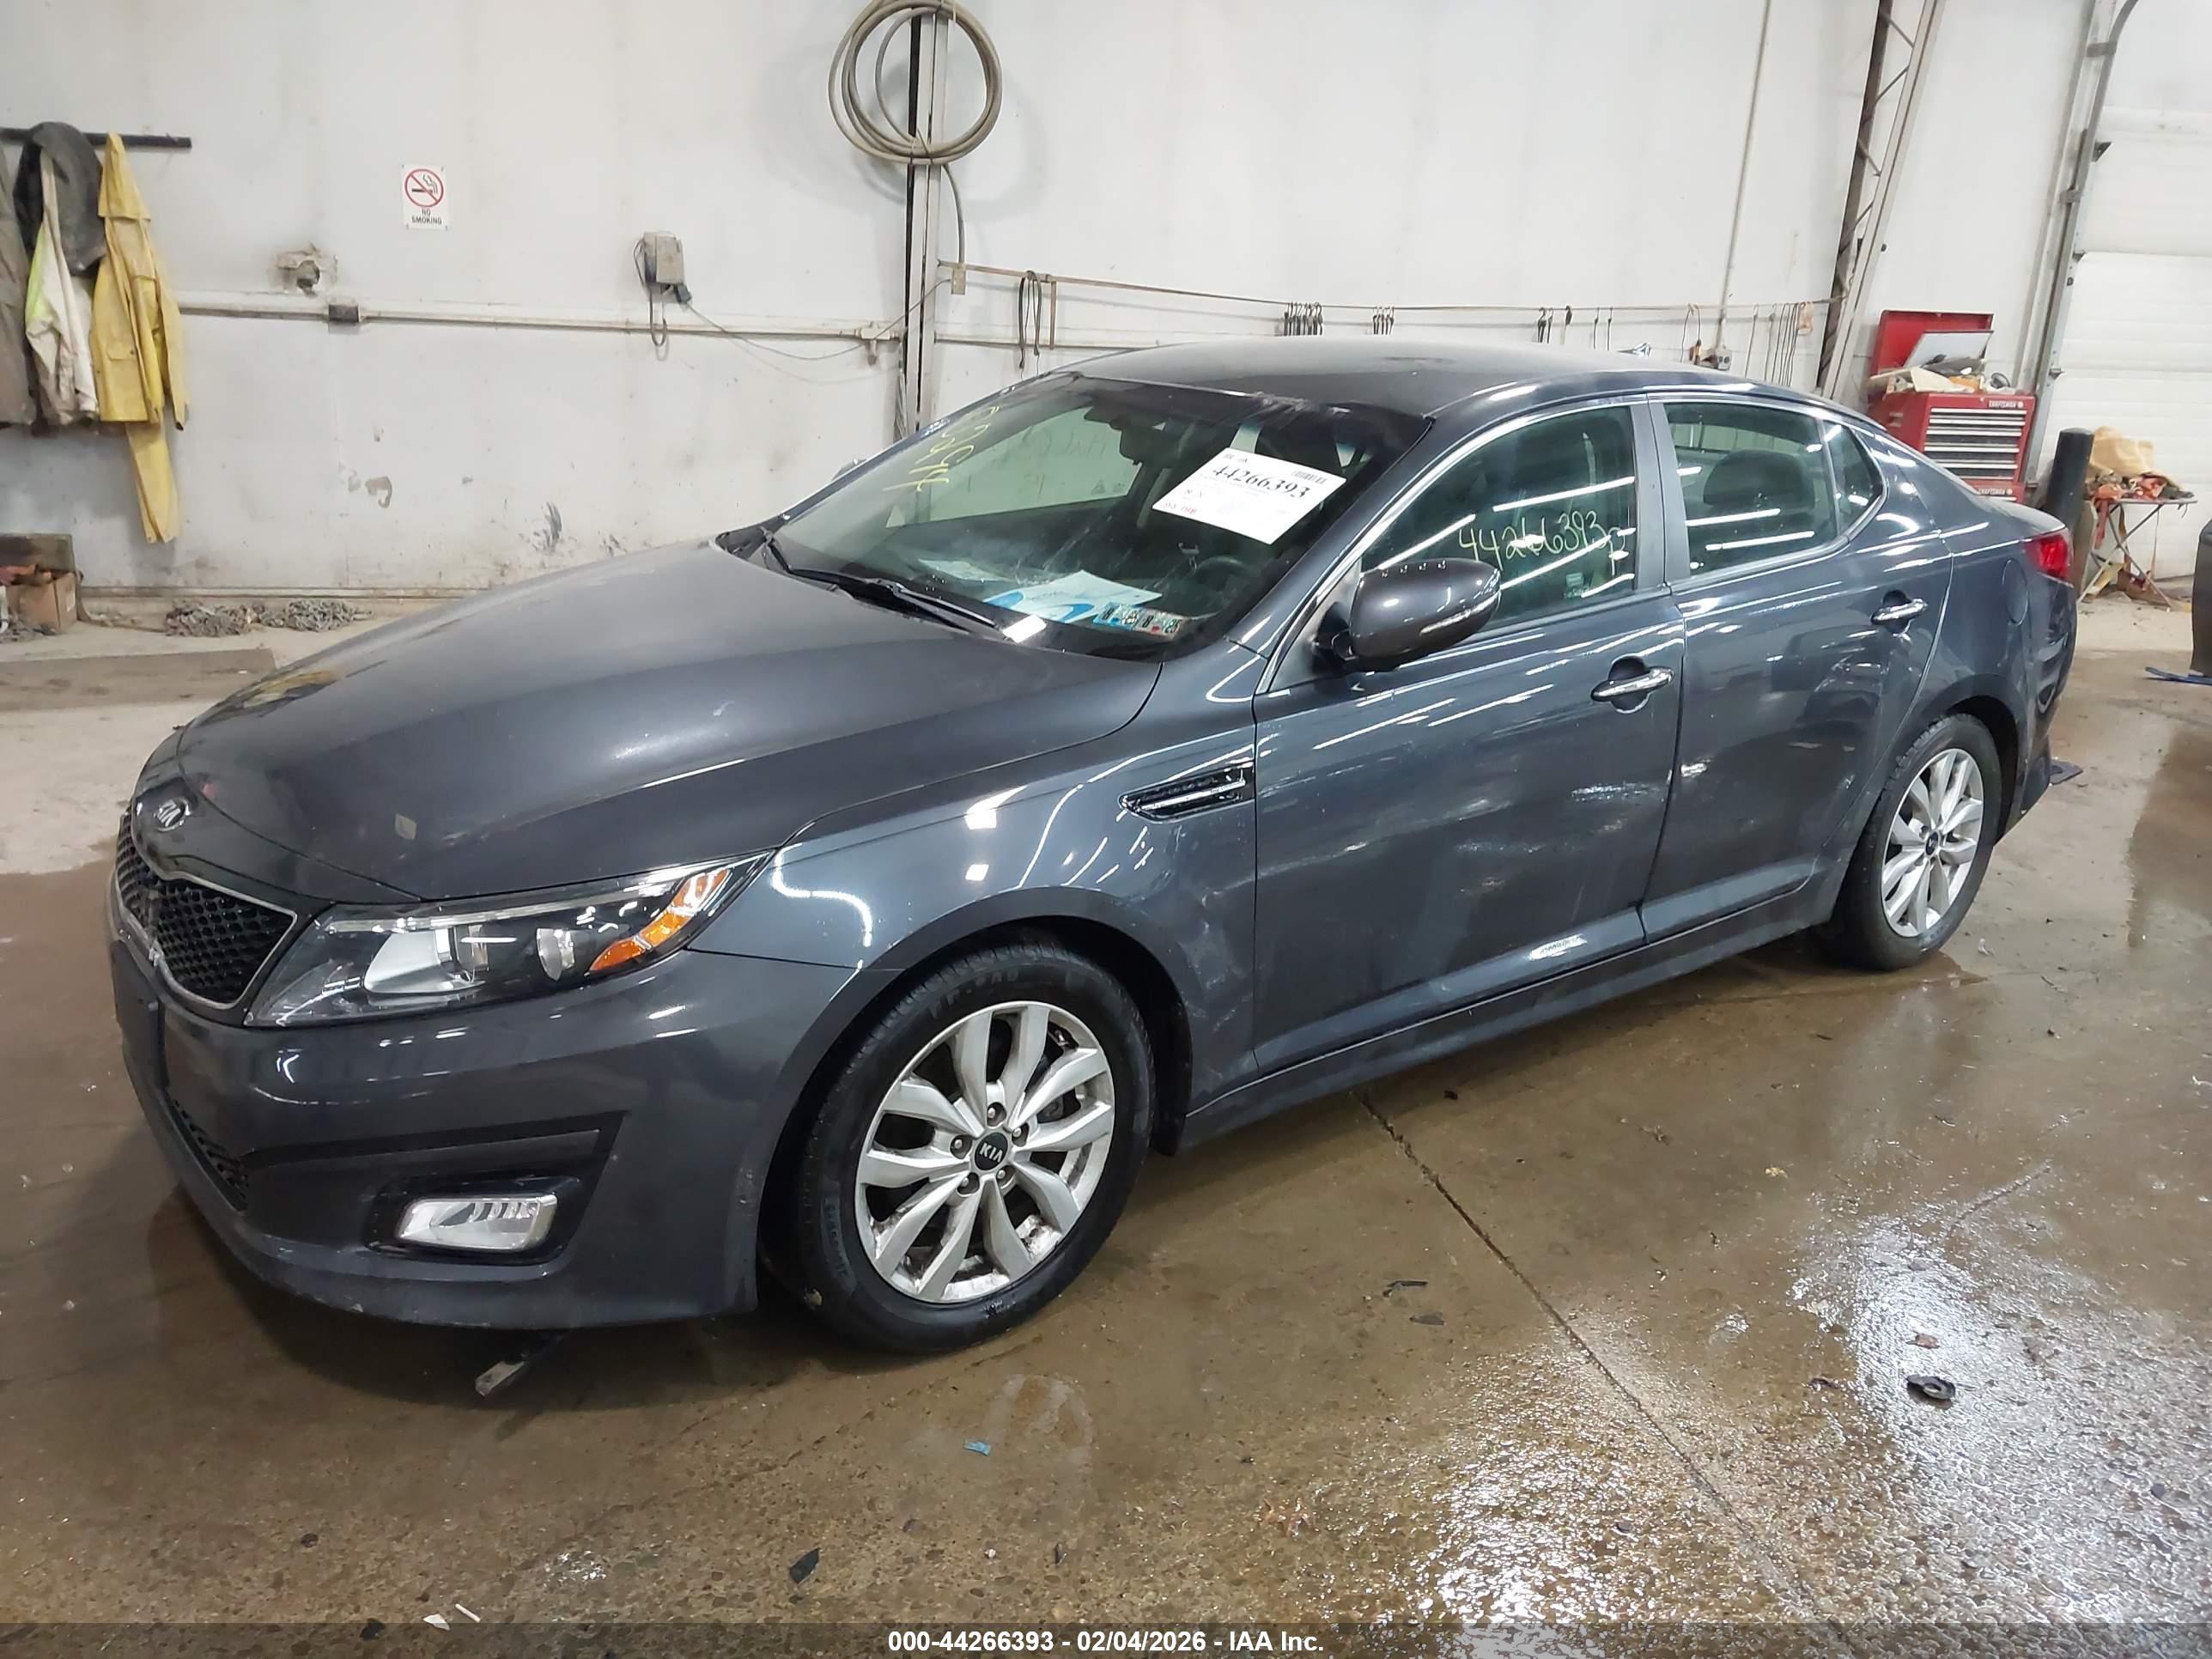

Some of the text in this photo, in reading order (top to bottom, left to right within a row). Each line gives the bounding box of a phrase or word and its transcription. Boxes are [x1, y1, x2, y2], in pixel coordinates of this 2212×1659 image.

[411, 216, 442, 225] SMOKING
[1212, 465, 1310, 499] 44266393
[979, 1142, 1003, 1163] KIA
